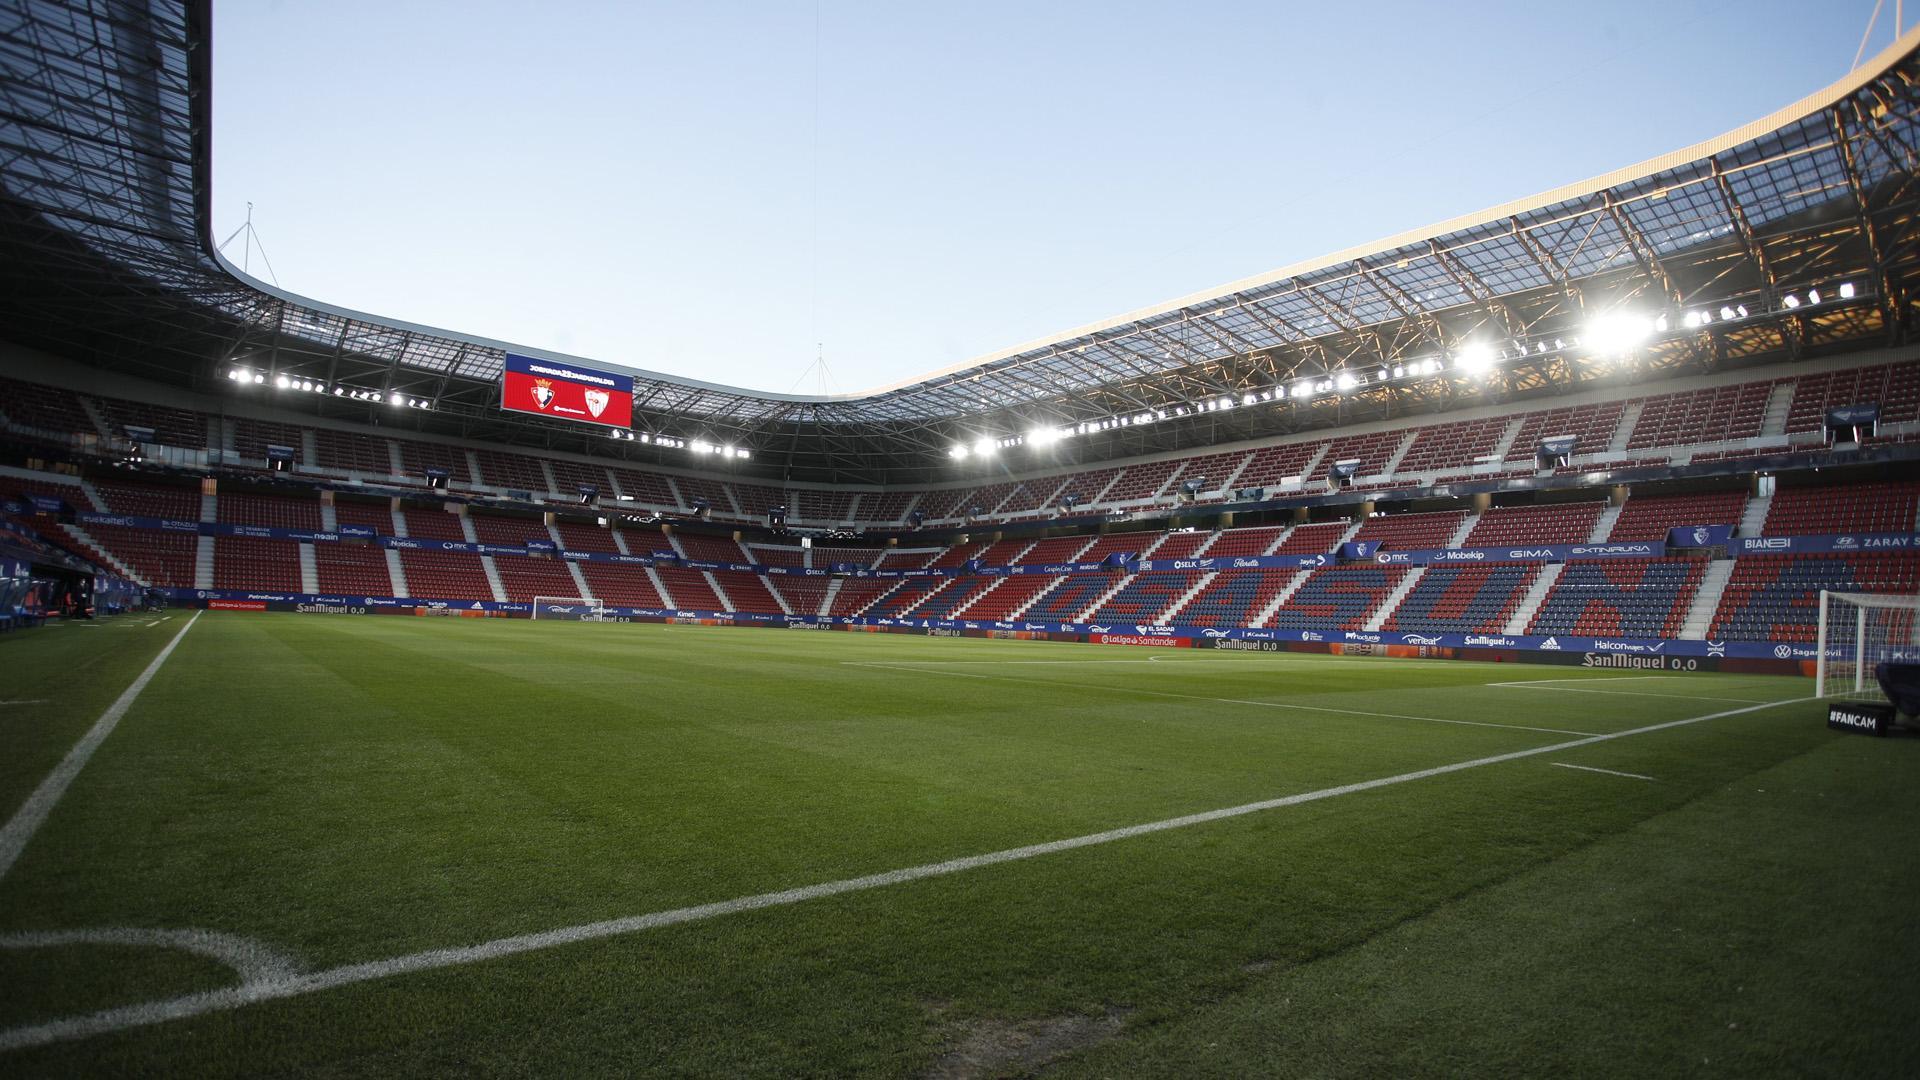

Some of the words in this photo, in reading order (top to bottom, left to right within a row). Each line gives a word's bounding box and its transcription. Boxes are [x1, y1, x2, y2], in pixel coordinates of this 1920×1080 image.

[83, 515, 124, 526] euskaltel
[391, 540, 417, 548] Noticias
[1864, 538, 1909, 547] ZARAY
[1392, 553, 1409, 561] mrc
[1447, 551, 1485, 561] Mobekip
[1509, 549, 1553, 558] GIMA
[1180, 560, 1197, 568] SELK
[296, 602, 347, 615] SanMiguel
[789, 620, 819, 630] SanMiguel
[1109, 635, 1131, 645] LaLiga
[1138, 636, 1176, 647] Santander
[1215, 637, 1260, 651] SanMiguel
[1464, 635, 1505, 646] SanMiguel
[1581, 651, 1665, 669] SanMiguel
[1671, 658, 1697, 672] 0,0
[1829, 710, 1877, 730] #FANCAM
